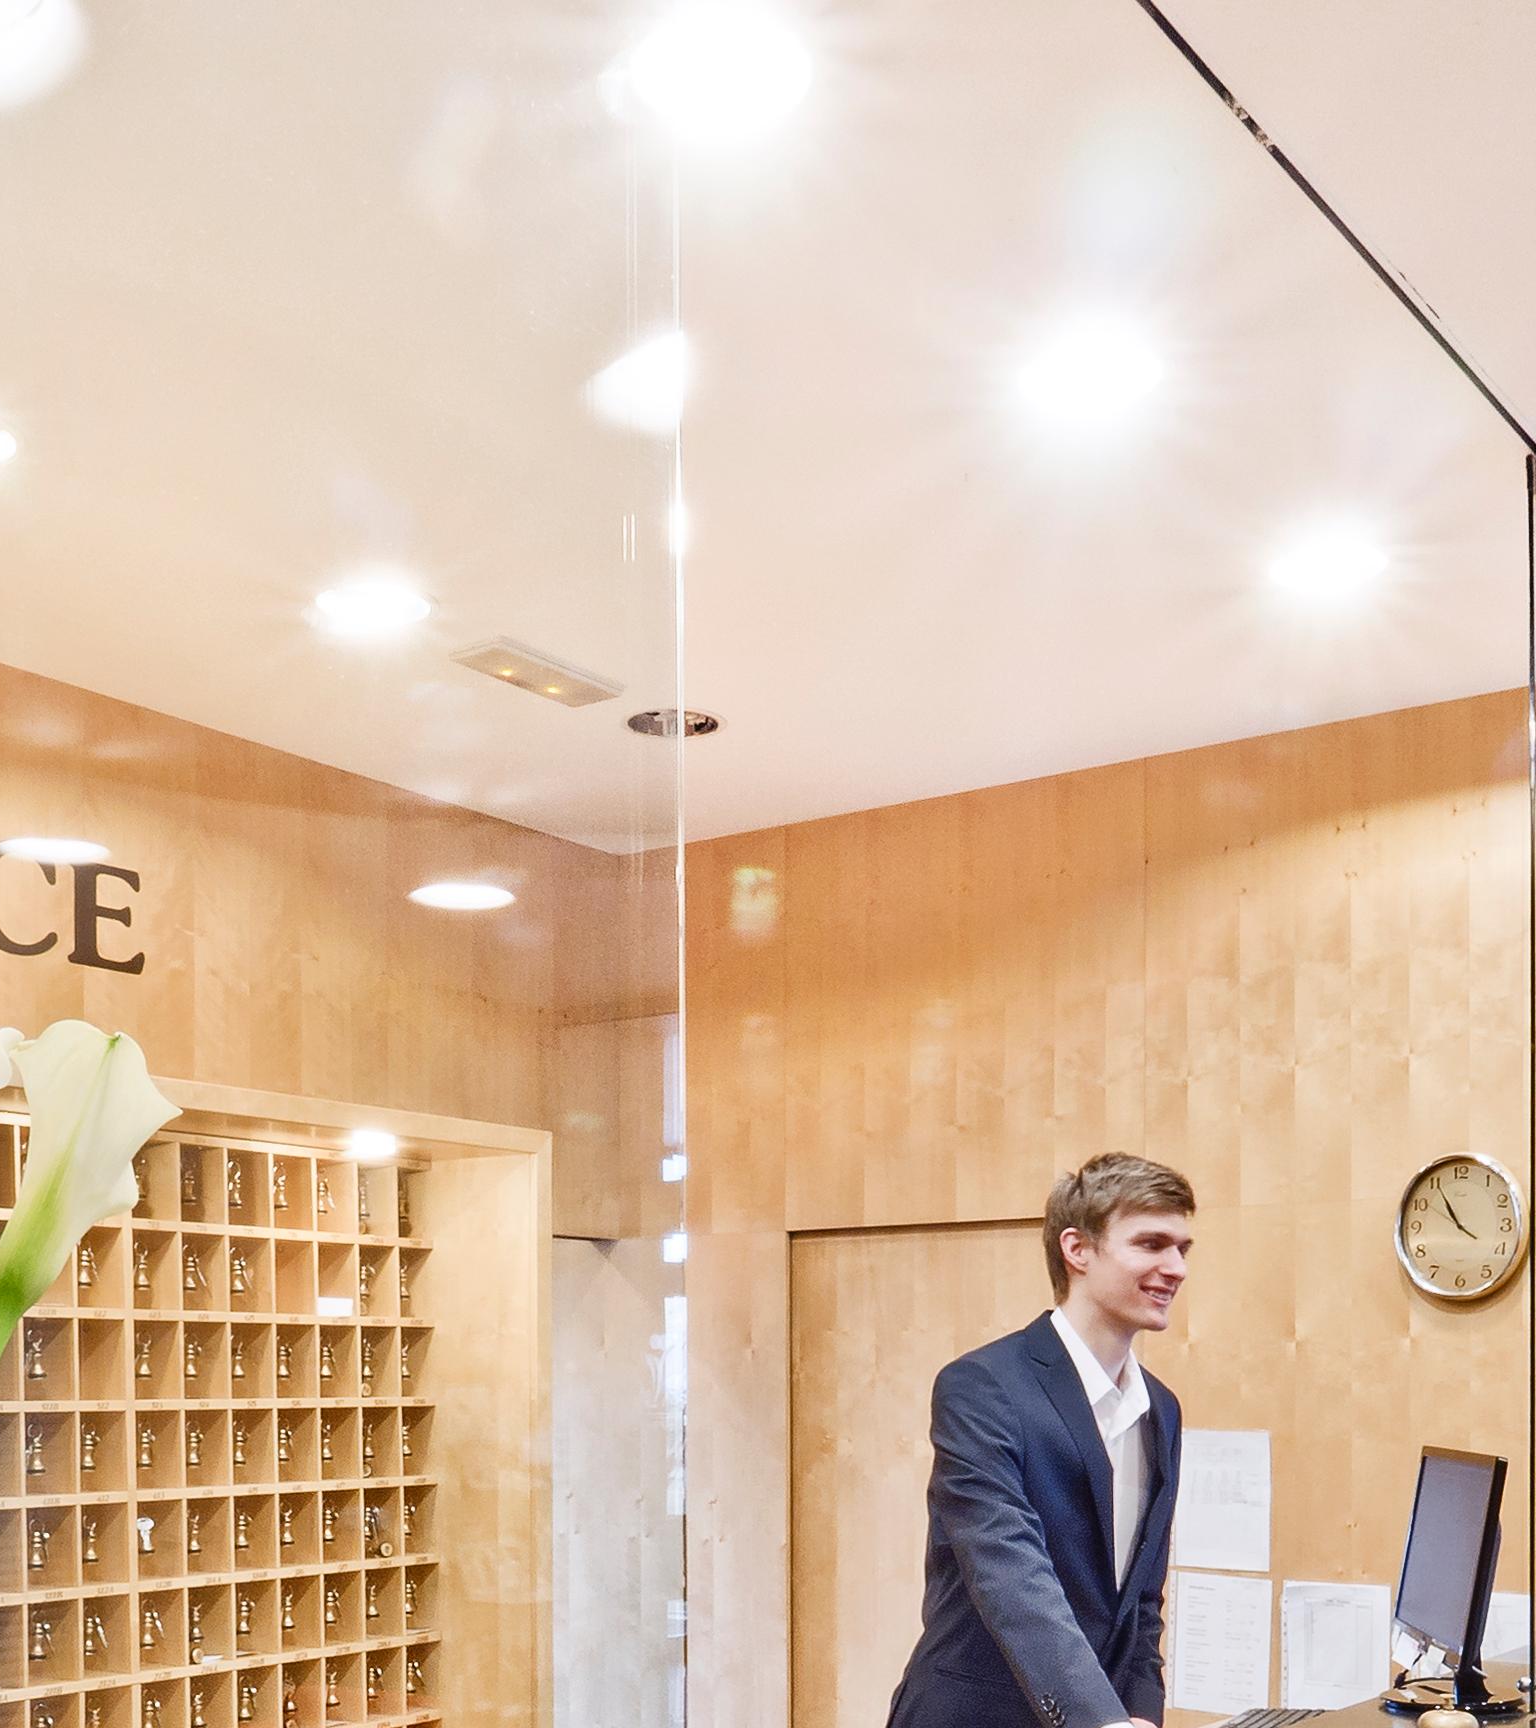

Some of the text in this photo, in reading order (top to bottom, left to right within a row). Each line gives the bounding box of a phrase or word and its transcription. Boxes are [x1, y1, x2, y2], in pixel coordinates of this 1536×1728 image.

[1454, 1166, 1469, 1179] 12
[1430, 1177, 1440, 1189] 11
[1486, 1174, 1491, 1187] 1
[1414, 1198, 1428, 1211] 10
[1497, 1193, 1508, 1208] 2
[1411, 1220, 1422, 1233] 9
[1500, 1217, 1512, 1232] 3
[1415, 1244, 1426, 1258] 8
[1494, 1242, 1506, 1255] 4
[1429, 1265, 1439, 1279] 7
[1481, 1264, 1492, 1278] 5
[1455, 1274, 1466, 1288] 6
